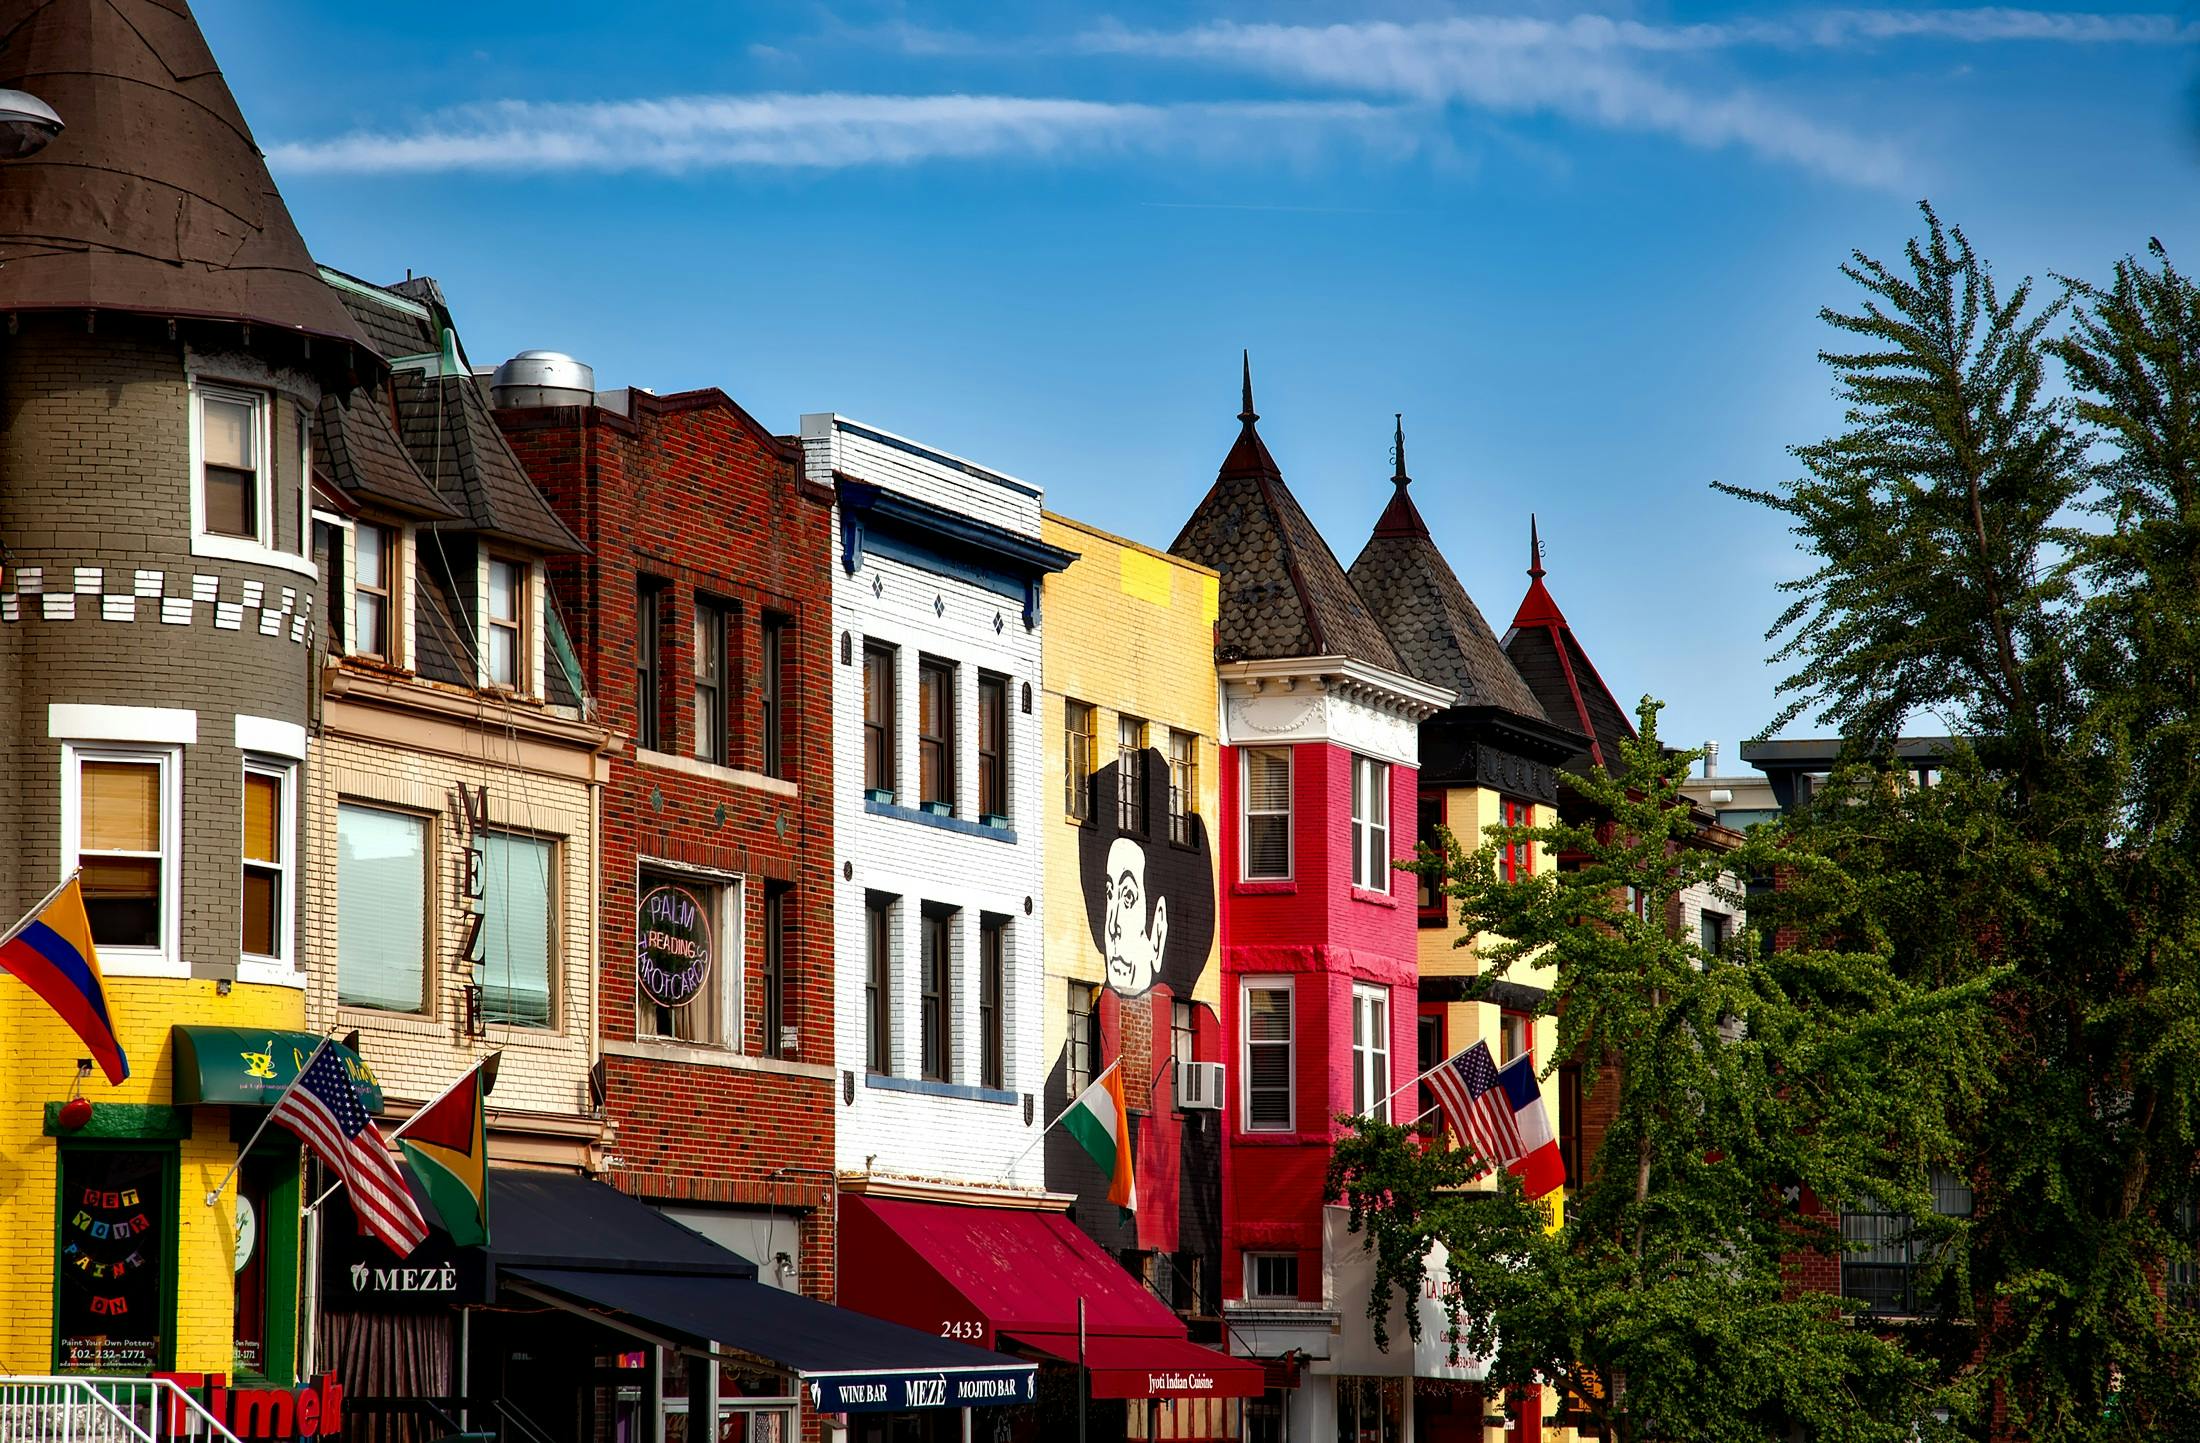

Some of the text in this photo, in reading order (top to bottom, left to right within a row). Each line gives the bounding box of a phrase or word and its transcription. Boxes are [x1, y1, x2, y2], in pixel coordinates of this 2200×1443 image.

[651, 895, 695, 932] PALM
[648, 930, 696, 960] READING
[83, 1187, 140, 1209] GET
[72, 1210, 150, 1240] YOUR
[64, 1243, 145, 1280] PAINT
[374, 1261, 457, 1292] MEZÈ
[90, 1295, 129, 1316] ON
[940, 1320, 983, 1339] 2433
[61, 1338, 155, 1349] Paint Your Own Pottery
[70, 1349, 146, 1359] 202-232-1771
[838, 1373, 1016, 1407] WINE BAR MEZÈ MOJITO BAR
[1148, 1372, 1213, 1394] Jyoti Indian Cuisine
